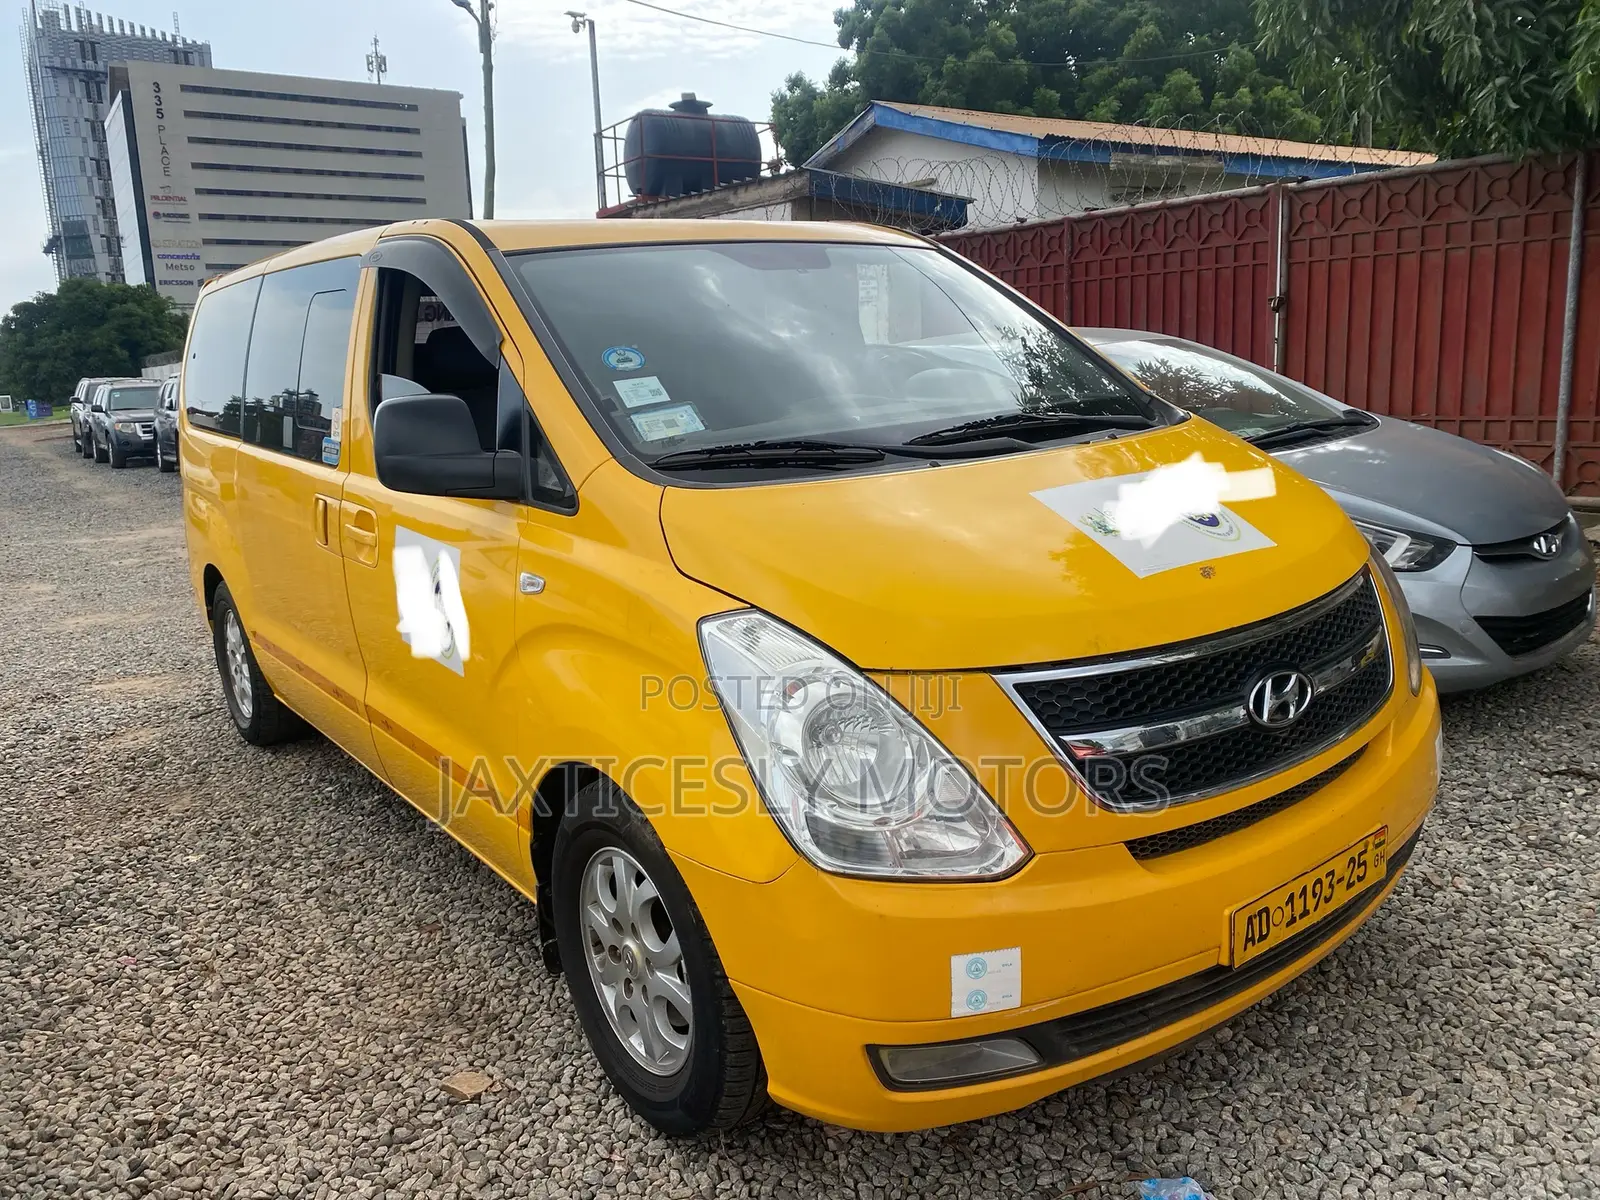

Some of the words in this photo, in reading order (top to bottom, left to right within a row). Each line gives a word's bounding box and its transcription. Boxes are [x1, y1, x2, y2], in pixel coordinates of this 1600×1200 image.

[152, 81, 164, 119] 335
[157, 124, 171, 177] PLACE
[165, 263, 195, 271] Metso
[1373, 850, 1386, 868] GH
[1244, 906, 1270, 952] AD
[1285, 849, 1367, 928] 1193-25
